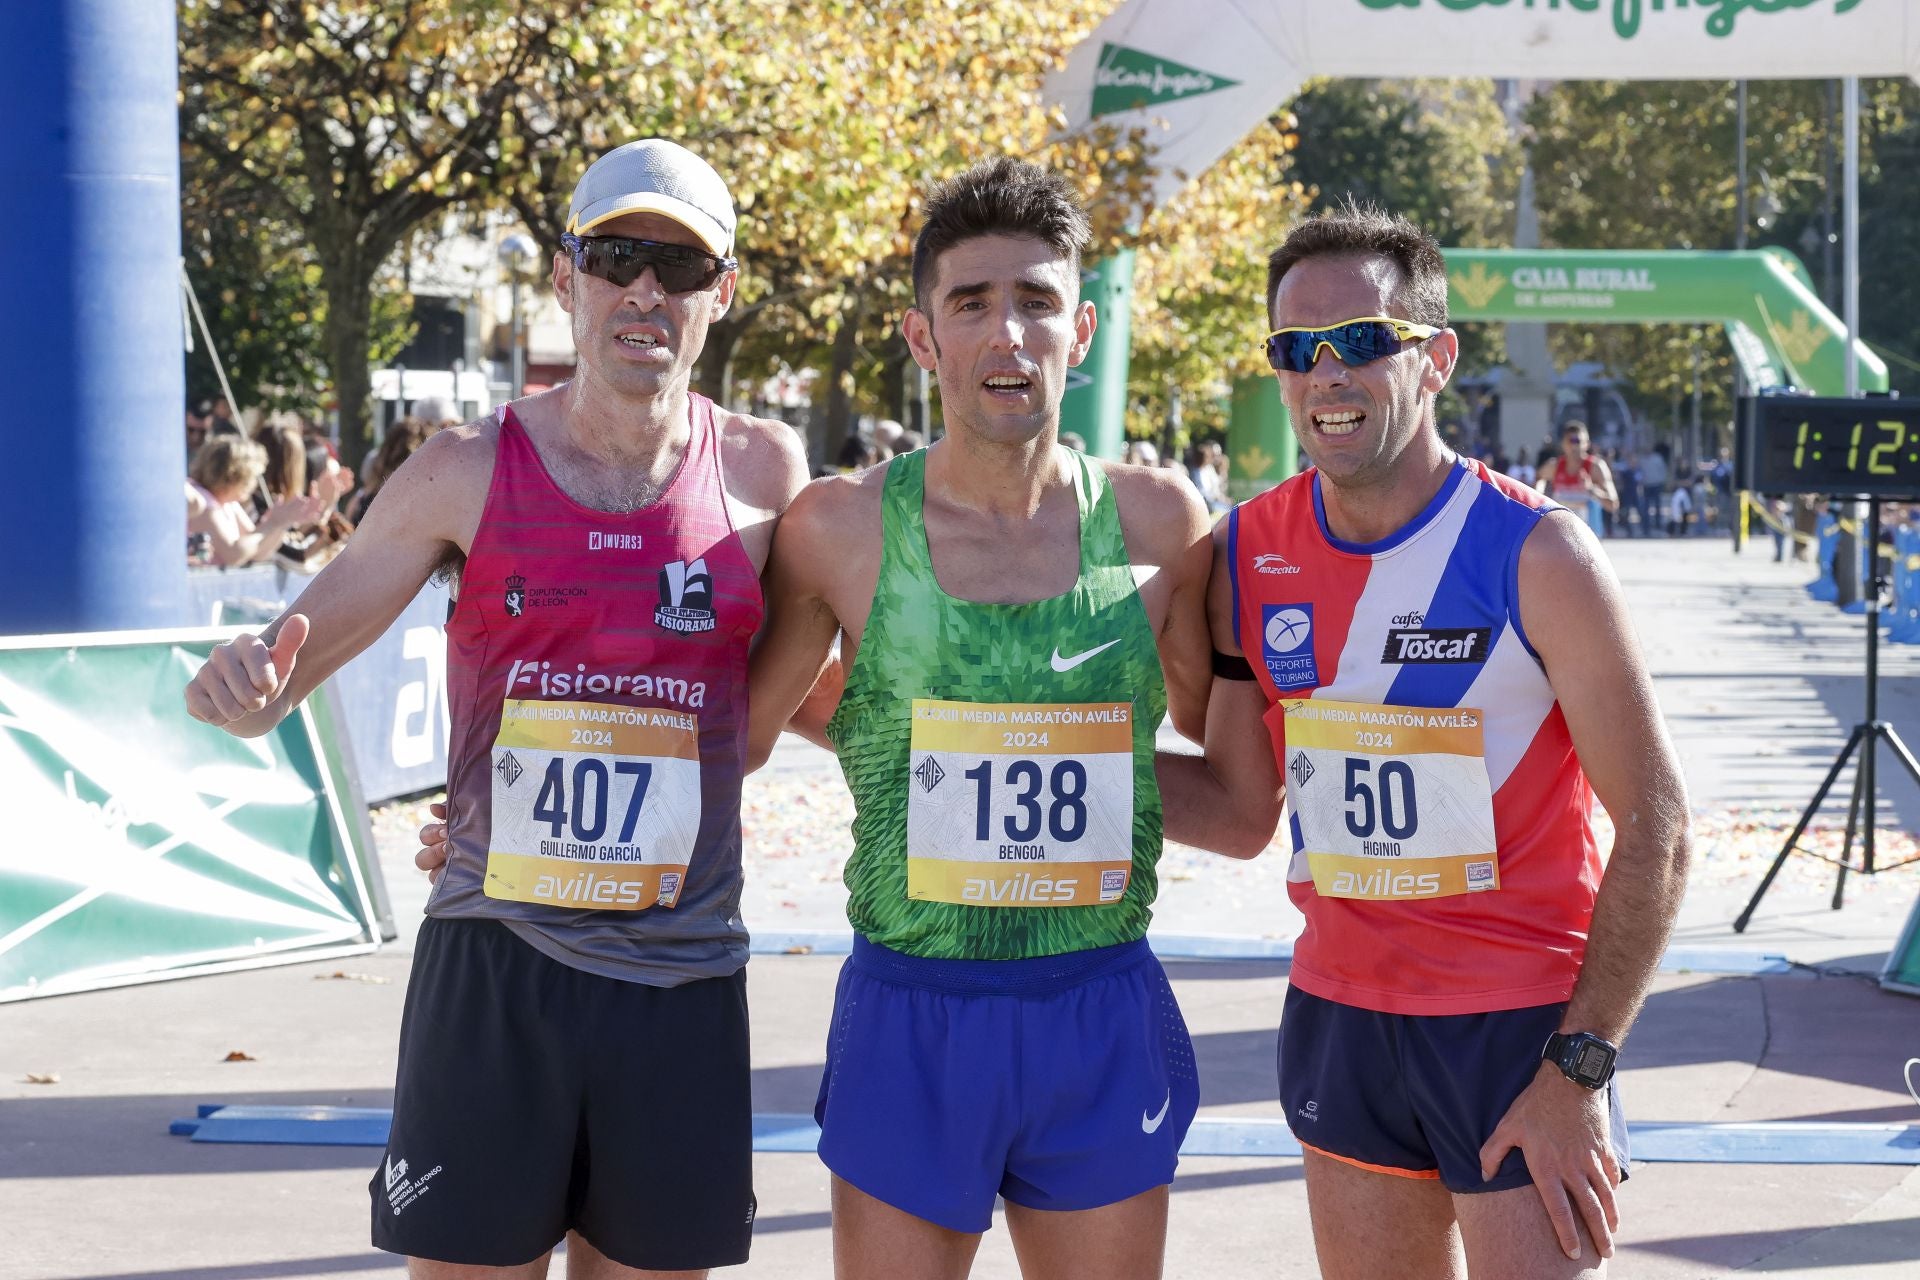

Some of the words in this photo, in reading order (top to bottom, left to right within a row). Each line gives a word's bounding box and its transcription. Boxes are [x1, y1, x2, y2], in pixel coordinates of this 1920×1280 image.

[1511, 266, 1569, 290] CAJA
[1575, 267, 1656, 291] RURAL
[528, 599, 540, 607] DE
[542, 597, 569, 607] LEÓN
[529, 587, 588, 597] DIPUTACIÓN
[654, 612, 716, 632] FISIORAMA
[1391, 611, 1425, 629] cafés
[1396, 632, 1478, 660] Toscaf
[1266, 659, 1313, 670] DEPORTE
[505, 660, 706, 708] Fisiorama
[540, 708, 577, 721] MEDIA
[579, 709, 647, 726] MARATÓN
[650, 713, 694, 731] AVILÉS
[962, 711, 1008, 724] MEDIA
[1010, 708, 1083, 724] MARATÓN
[1085, 706, 1128, 723] AVILÉS
[1321, 709, 1358, 722] MEDIA
[1360, 711, 1425, 728] MARATÓN
[1427, 712, 1478, 729] AVILÉS
[570, 729, 613, 747] 2024
[1002, 732, 1049, 748] 2024
[1355, 731, 1393, 748] 2024
[533, 757, 653, 843] 407
[965, 759, 1087, 843] 138
[1344, 757, 1419, 840] 50
[540, 840, 596, 860] GUILLERMO
[599, 844, 642, 862] GARCÍA
[999, 845, 1046, 860] BENGOA
[1363, 841, 1401, 857] HIGINIO
[532, 872, 643, 904] avilés
[961, 873, 1079, 901] avilés
[1331, 868, 1441, 896] avilés
[388, 1178, 410, 1202] VALENCIA
[390, 1186, 414, 1208] TRINIDAD
[414, 1165, 442, 1189] ALFONSO
